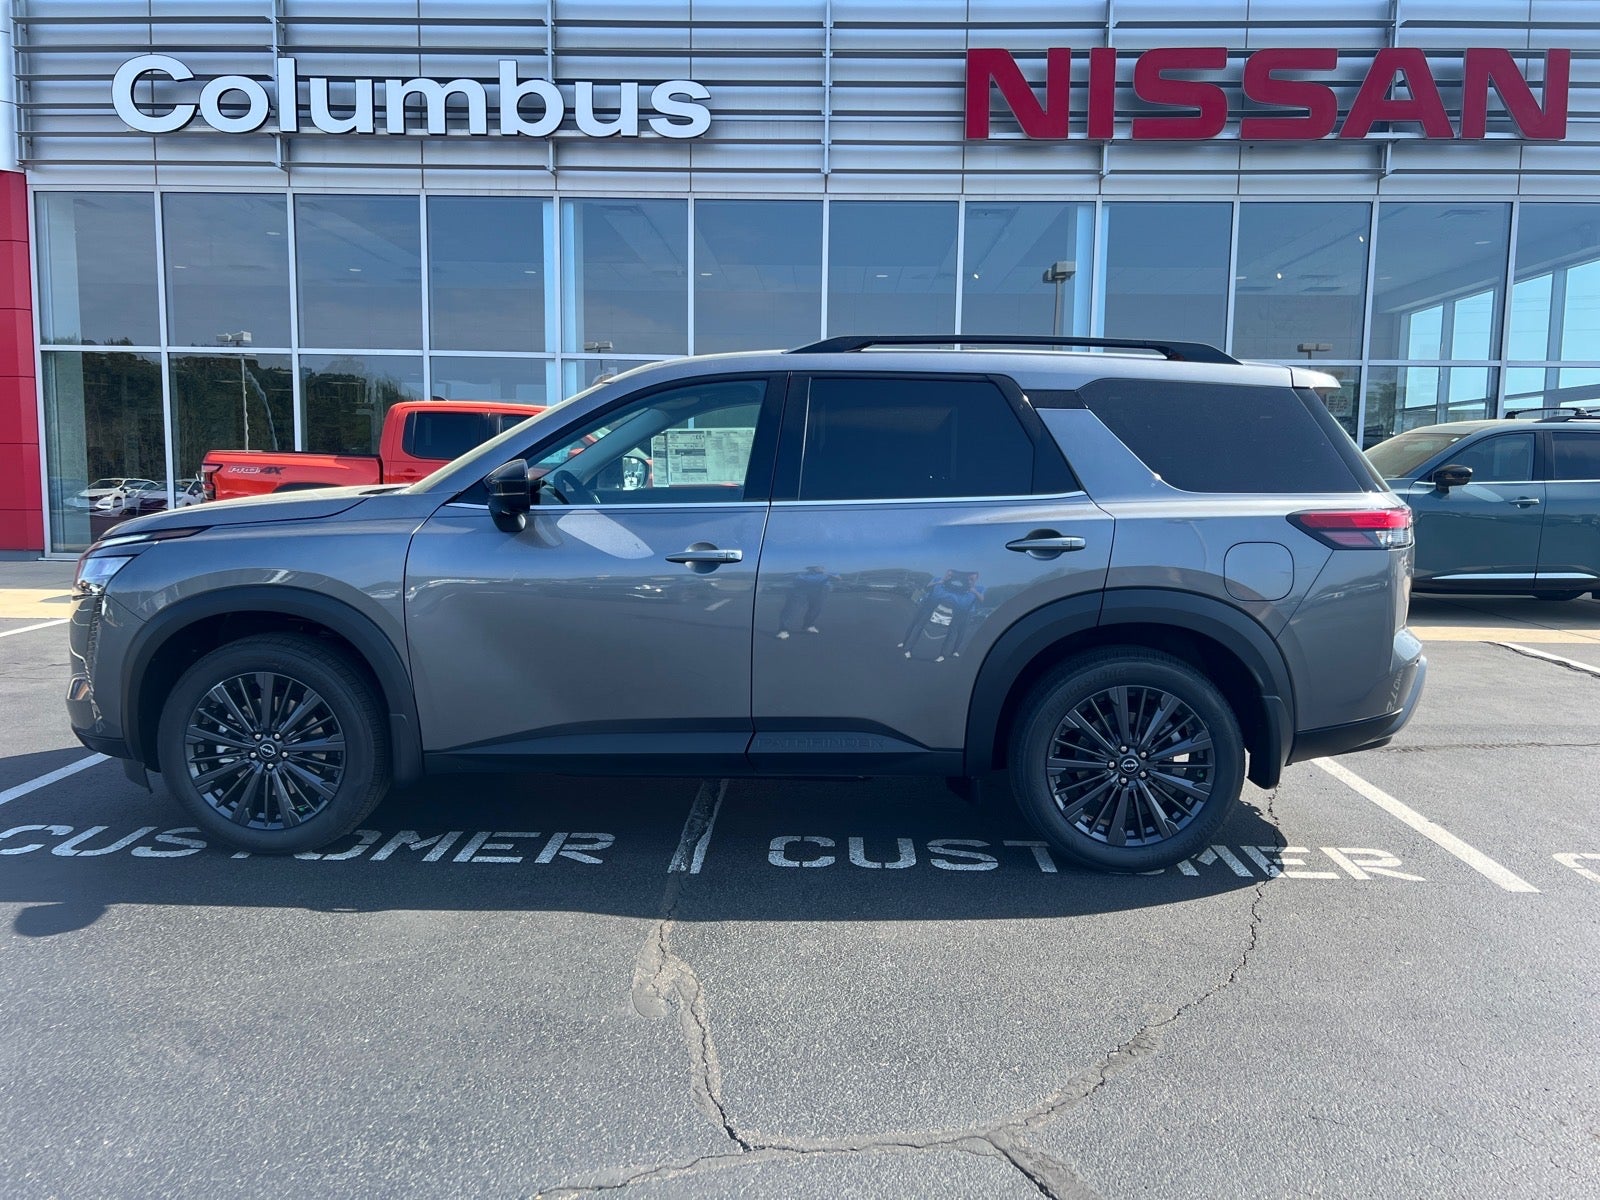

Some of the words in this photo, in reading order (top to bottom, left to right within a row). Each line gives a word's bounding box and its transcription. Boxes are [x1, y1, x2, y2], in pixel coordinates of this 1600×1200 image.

[111, 53, 713, 140] Columbus
[964, 47, 1571, 141] NISSAN
[0, 824, 616, 864] CUSOMER
[767, 834, 1425, 883] CUSTMER
